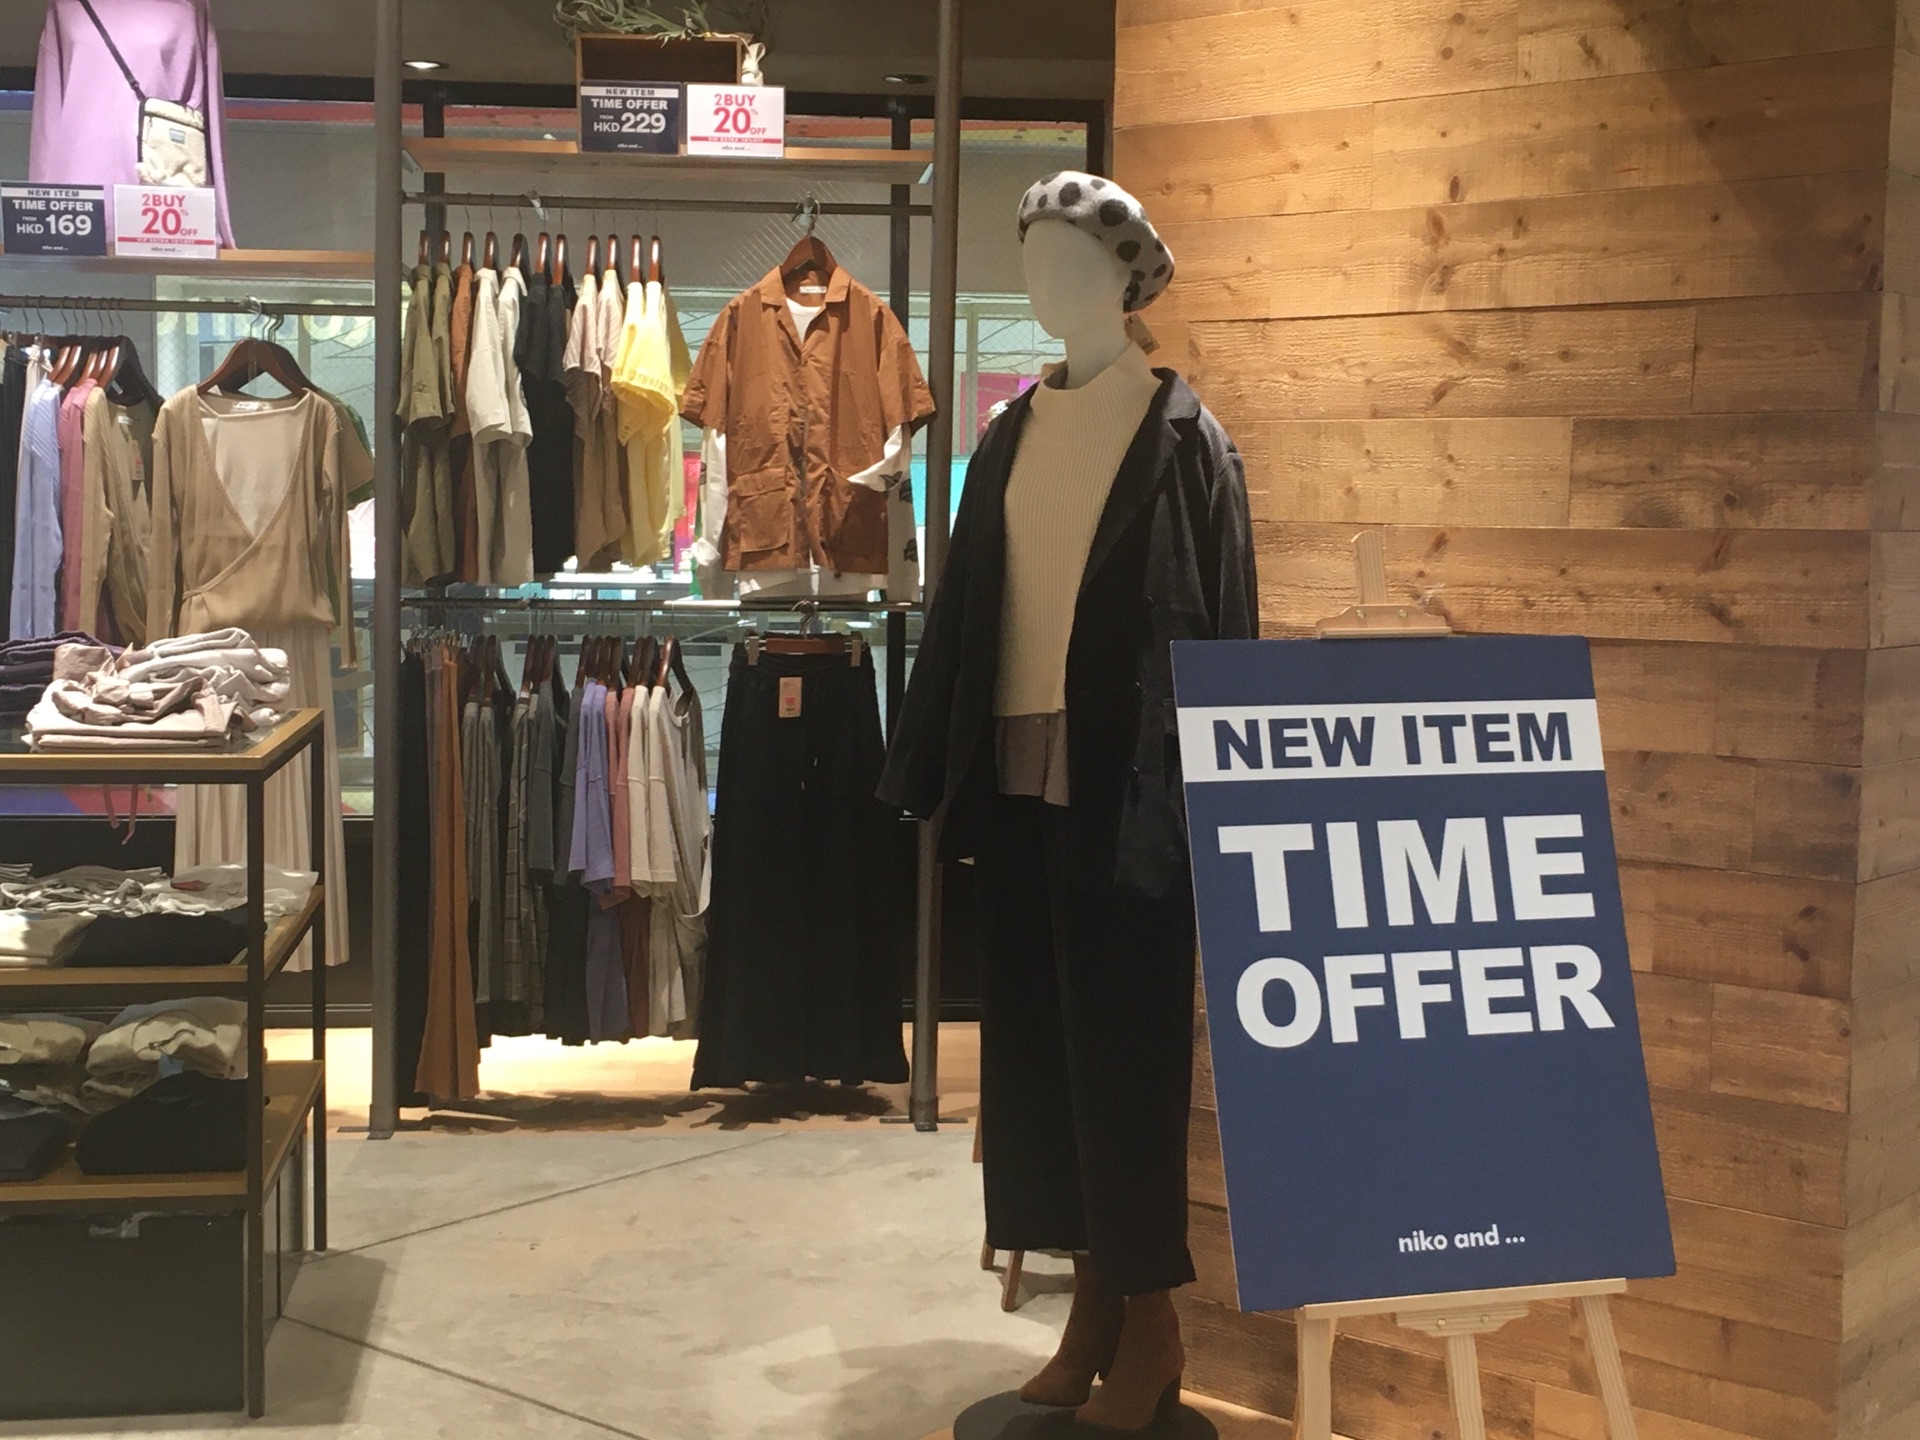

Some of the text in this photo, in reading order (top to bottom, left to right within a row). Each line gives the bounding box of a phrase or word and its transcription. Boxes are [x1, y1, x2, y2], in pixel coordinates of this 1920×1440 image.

[605, 88, 627, 96] NEW
[714, 93, 756, 107] 2BUY
[591, 98, 668, 110] TIME OFFER
[593, 112, 666, 134] HKD 229
[27, 189, 51, 197] NEW
[142, 193, 186, 208] 2BUY
[12, 199, 94, 212] TIME OFFER
[16, 214, 92, 236] HKD 169
[1212, 712, 1573, 770] NEW ITEM
[1217, 814, 1596, 933] TIME
[1235, 943, 1615, 1048] OFFER
[1398, 1229, 1448, 1253] niko
[1454, 1223, 1500, 1249] and
